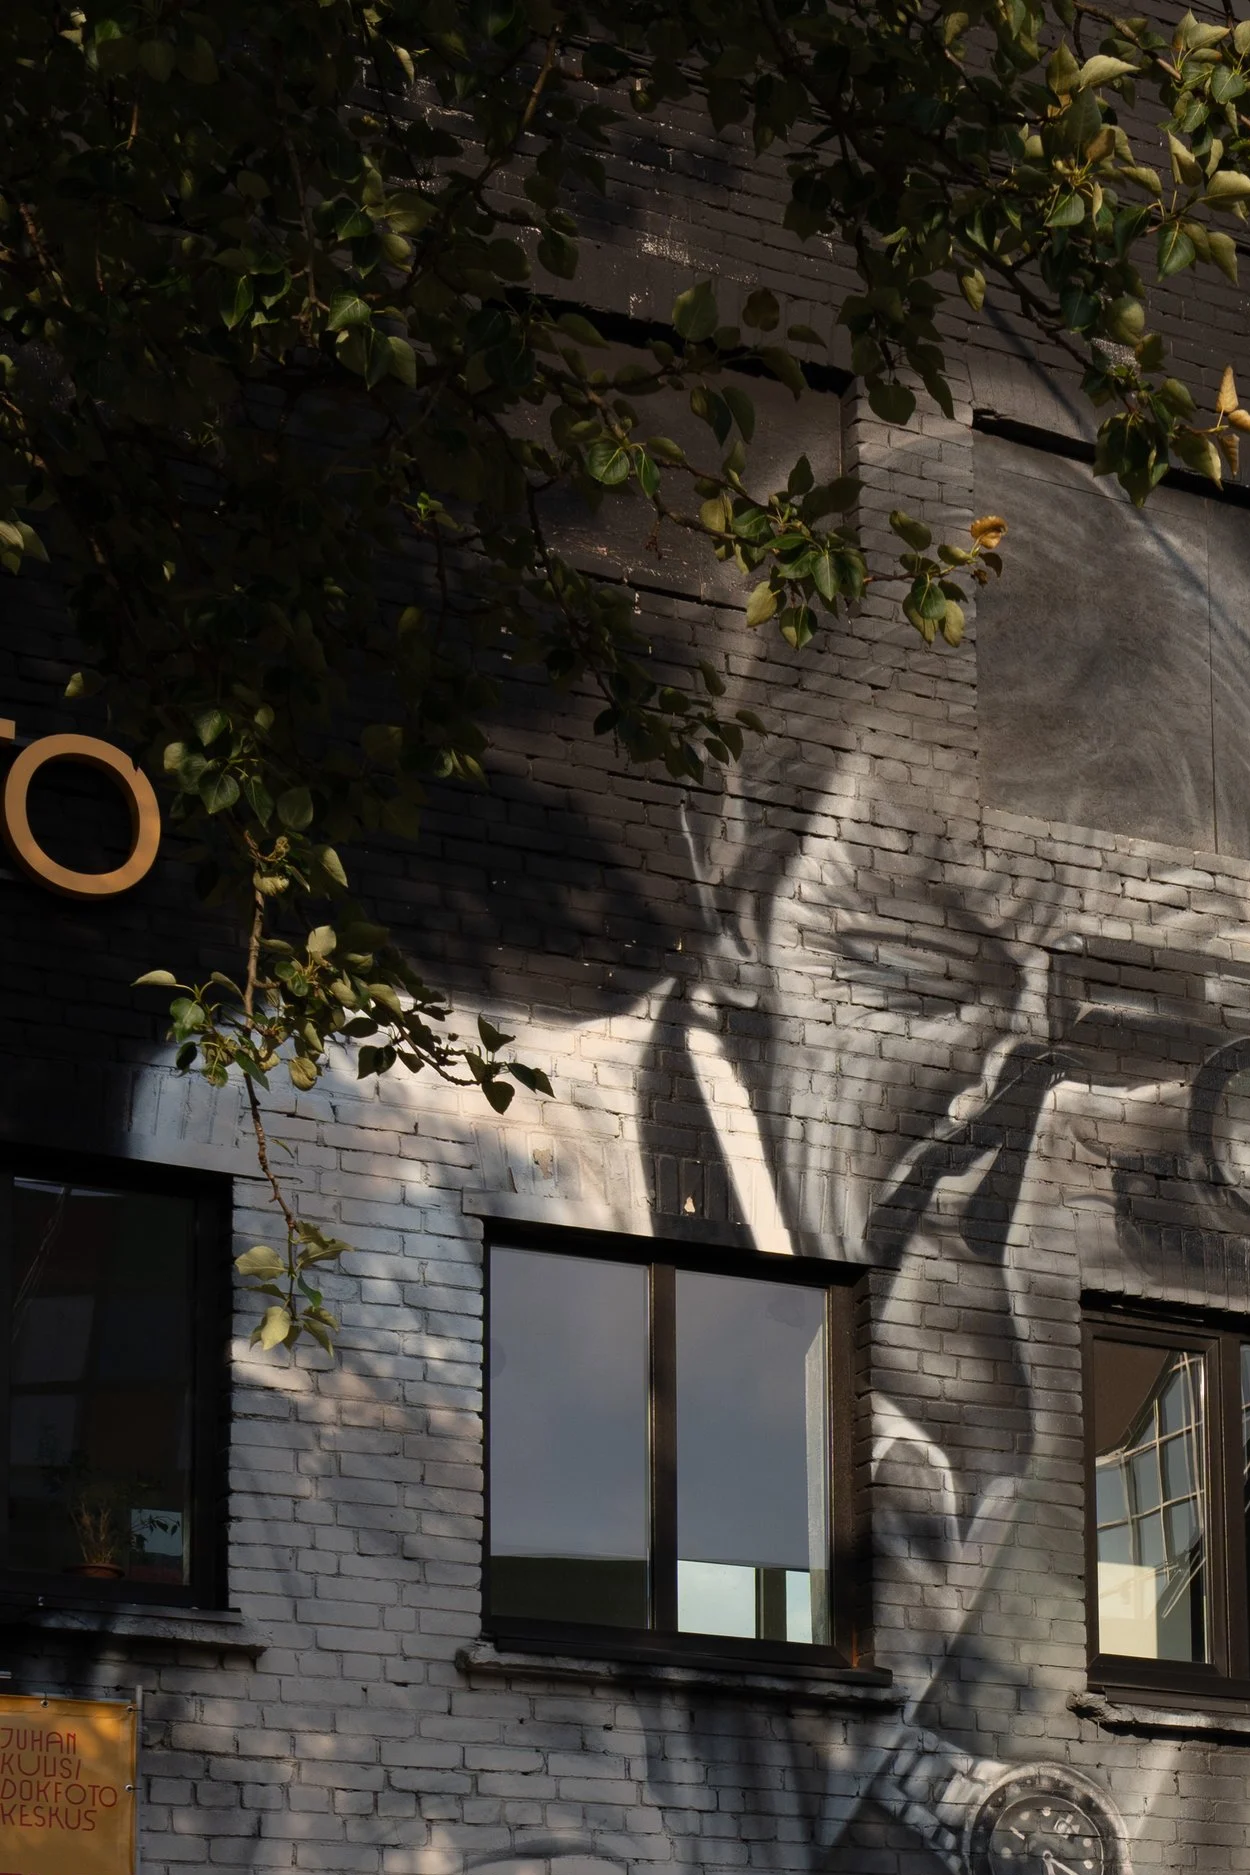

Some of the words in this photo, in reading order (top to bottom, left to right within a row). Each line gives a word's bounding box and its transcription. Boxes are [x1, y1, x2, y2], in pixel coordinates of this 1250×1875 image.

[0, 718, 160, 895] O
[0, 1727, 77, 1755] JUHAN
[0, 1753, 82, 1780] KUUSI
[0, 1778, 118, 1808] DOKFOTO
[0, 1802, 98, 1832] KESKUS
